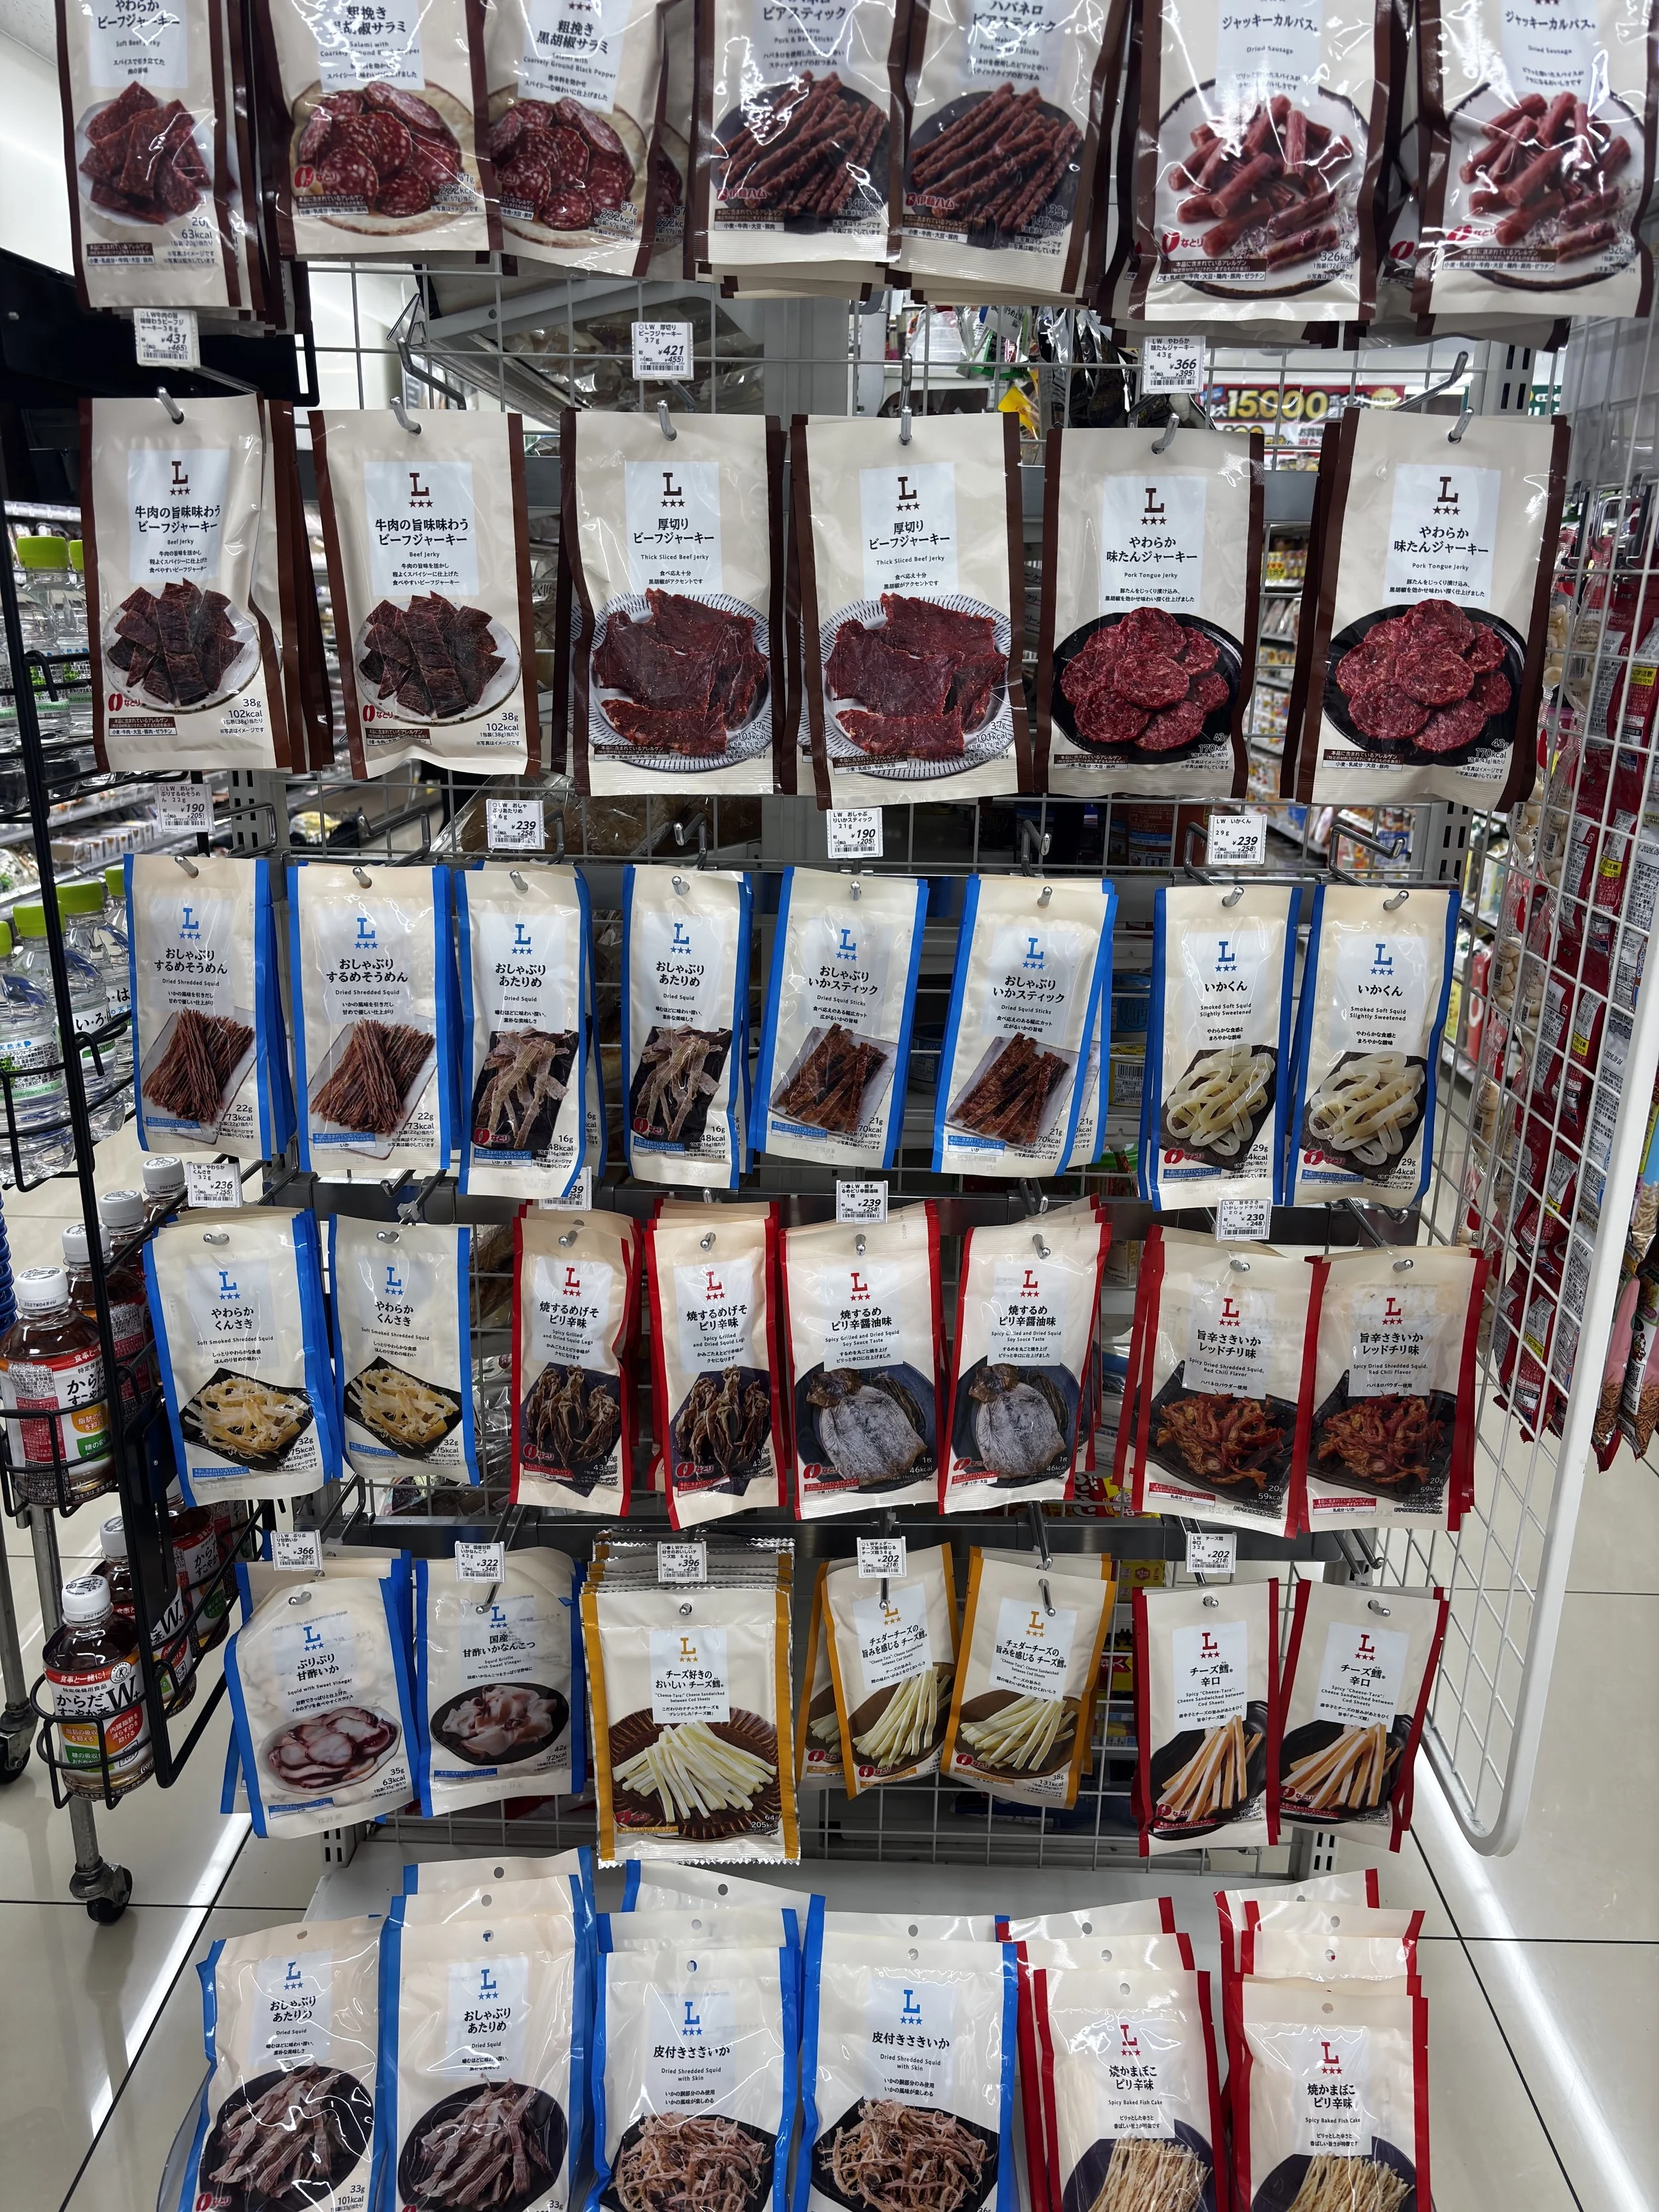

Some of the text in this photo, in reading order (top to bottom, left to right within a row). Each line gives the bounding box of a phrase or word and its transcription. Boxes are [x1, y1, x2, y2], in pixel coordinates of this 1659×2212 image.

[1222, 14, 1315, 31] ジャッキーカルパス
[1505, 11, 1591, 30] ジャッキーカルパス
[557, 20, 595, 37] 粗挽き
[536, 31, 609, 54] 黒胡椒サラミ
[171, 461, 188, 484] L
[135, 505, 220, 519] 牛肉の旨味味わう
[138, 520, 218, 532] ビーフジャーキー
[375, 518, 469, 532] 牛肉の旨味味わう
[658, 518, 689, 530] 厚切り
[893, 520, 924, 534] 厚切り
[378, 533, 467, 546] ビーフジャーキー
[633, 532, 714, 544] ビーフジャーキー
[1419, 527, 1469, 539] やわらか
[869, 534, 950, 550] ビーフジャーキー
[1129, 536, 1176, 547] やわらか
[1394, 540, 1488, 554] 味たんジャーキー
[1106, 550, 1197, 563] 味たんジャーキー
[1427, 563, 1451, 571] Tongue
[502, 712, 519, 721] 38g
[1476, 749, 1507, 758] 170kcal
[357, 917, 375, 939] L
[166, 948, 215, 962] おしゃぶり
[155, 961, 228, 974] するめそうめん
[340, 958, 394, 970] おしゃぶり
[495, 962, 547, 975] おしゃぶり
[656, 961, 705, 975] おしゃぶり
[326, 970, 408, 984] するめそうめん
[820, 966, 869, 981] おしゃぶり
[499, 974, 541, 988] あたりめ
[660, 974, 700, 988] あたりめ
[808, 977, 878, 995] いかスティック
[1005, 976, 1056, 990] おしゃぶり
[1204, 980, 1247, 993] いかくん
[993, 987, 1065, 1003] いかスティック
[1358, 984, 1402, 996] いかくん
[1004, 1024, 1043, 1033] 広がるいかの旨味
[236, 1104, 253, 1113] 22g
[548, 1143, 573, 1152] 48kcal
[1401, 1157, 1416, 1167] 29g
[211, 1307, 254, 1319] やわらか
[374, 1301, 413, 1314] やわらか
[540, 1301, 599, 1319] 焼するめげそ
[686, 1304, 747, 1321] 焼するめげそ
[840, 1306, 882, 1320] 焼するめ
[1008, 1305, 1048, 1316] 焼するめ
[214, 1317, 252, 1331] くんさき
[377, 1313, 411, 1327] くんさき
[549, 1315, 587, 1329] ピリ辛味
[699, 1317, 739, 1331] ピリ辛味
[831, 1317, 892, 1332] ピリ辛醤油味
[999, 1315, 1056, 1327] ピリ辛醤油味
[1197, 1330, 1262, 1346] 旨辛さきいか
[1360, 1333, 1423, 1345] 旨辛さきいか
[1199, 1343, 1256, 1360] レッドチリ味
[1362, 1345, 1419, 1357] レッドチリ味
[490, 1635, 508, 1644] 国産
[869, 1625, 918, 1645] チェダーチーズの
[463, 1641, 535, 1657] 甘酢いかなんこつ
[1006, 1639, 1059, 1657] チェダーチーズの
[297, 1653, 335, 1671] ぷりぷり
[297, 1664, 340, 1681] 甘酢いか
[666, 1670, 712, 1680] チーズ好きの
[1200, 1676, 1220, 1686] 辛口
[1350, 1676, 1370, 1686] 辛口
[57, 1696, 103, 1708] からだ
[270, 1996, 316, 2011] おしゃぶり
[273, 2008, 313, 2022] あたりめ
[464, 2007, 511, 2022] おしゃぶり
[467, 2021, 506, 2033] あたりめ
[872, 2031, 950, 2049] 皮付きさきいか
[654, 2045, 731, 2059] 皮付きさきいか
[1109, 2065, 1157, 2077] 焼かまぼこ
[1116, 2079, 1154, 2091] ピリ辛味
[1307, 2084, 1356, 2096] 焼かまぼこ
[1313, 2097, 1353, 2109] ピリ辛味
